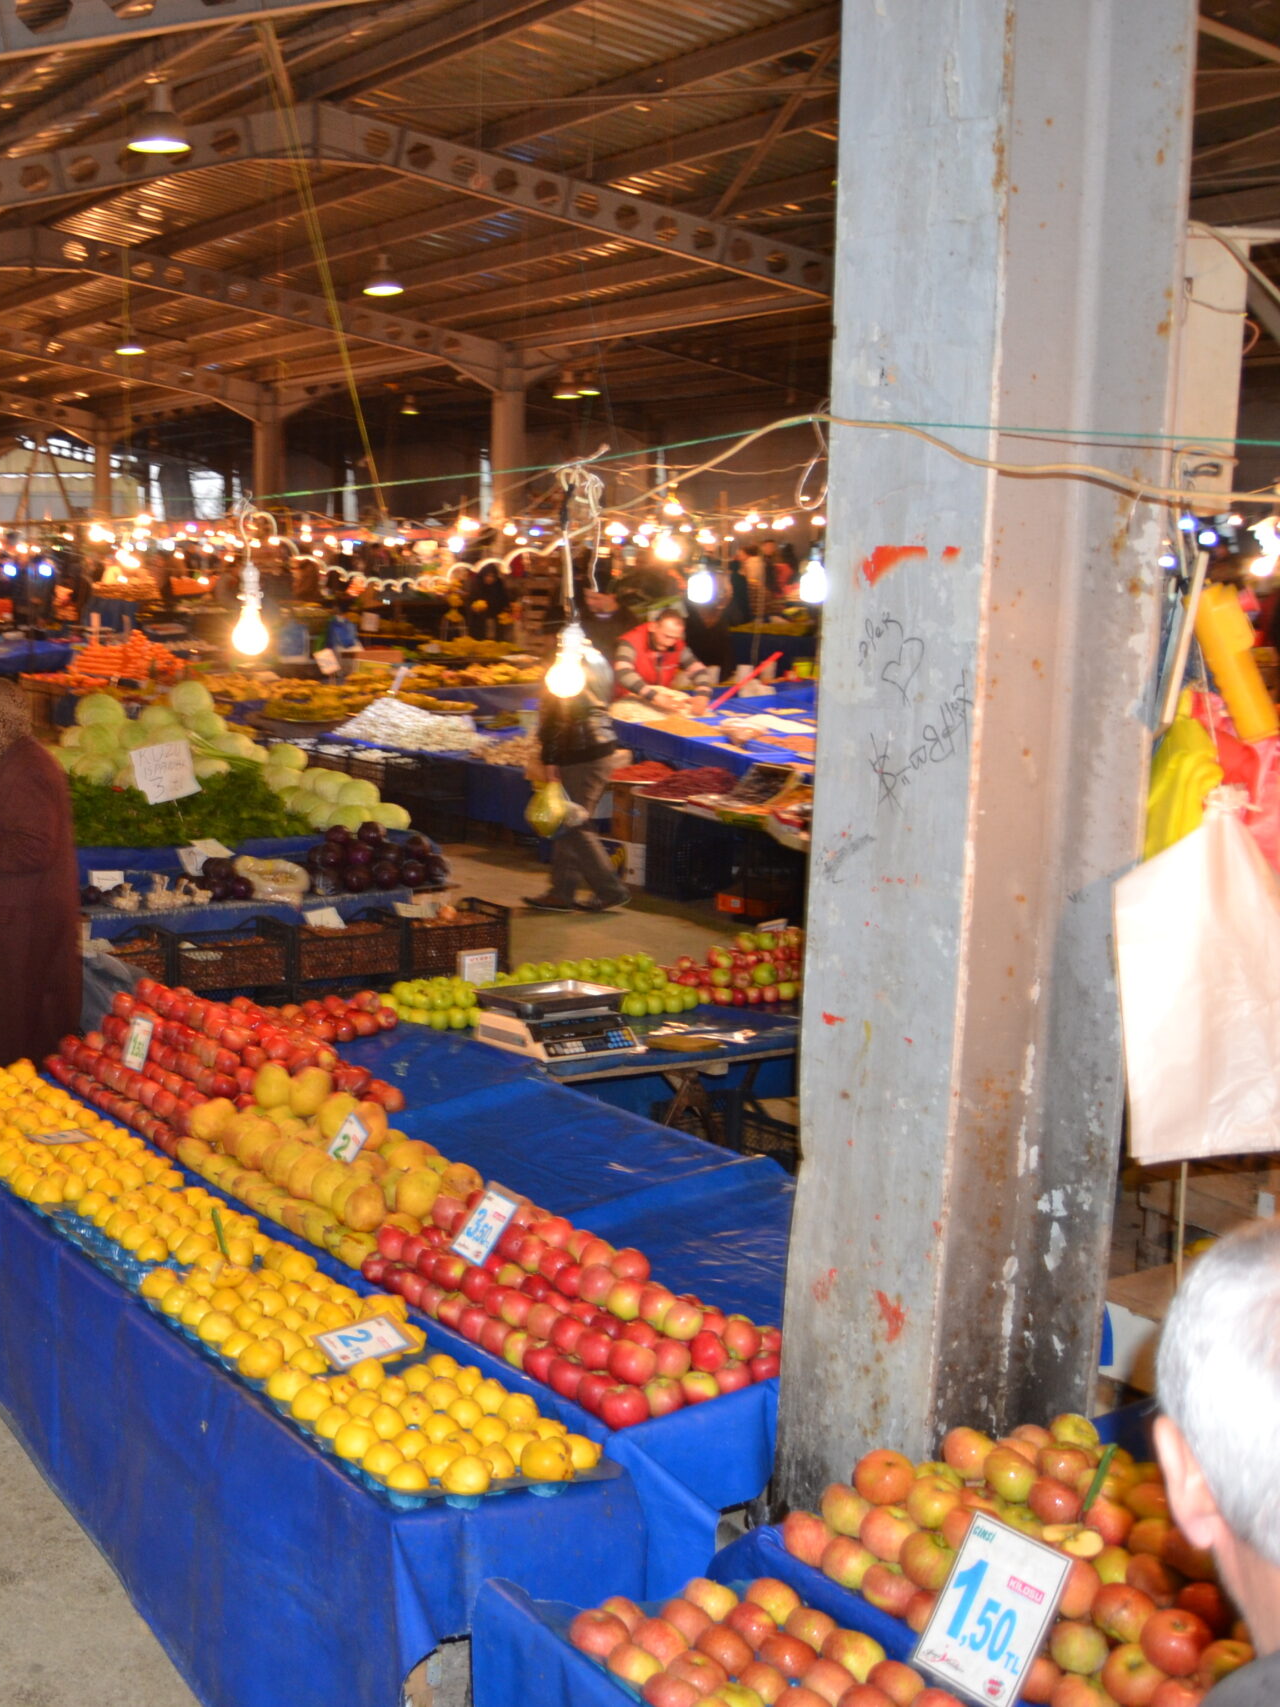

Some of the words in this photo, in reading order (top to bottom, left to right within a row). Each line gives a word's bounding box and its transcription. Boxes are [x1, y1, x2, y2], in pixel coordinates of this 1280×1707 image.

[333, 1133, 351, 1159] 2
[337, 1328, 373, 1348] 2
[1003, 1651, 1020, 1676] TL
